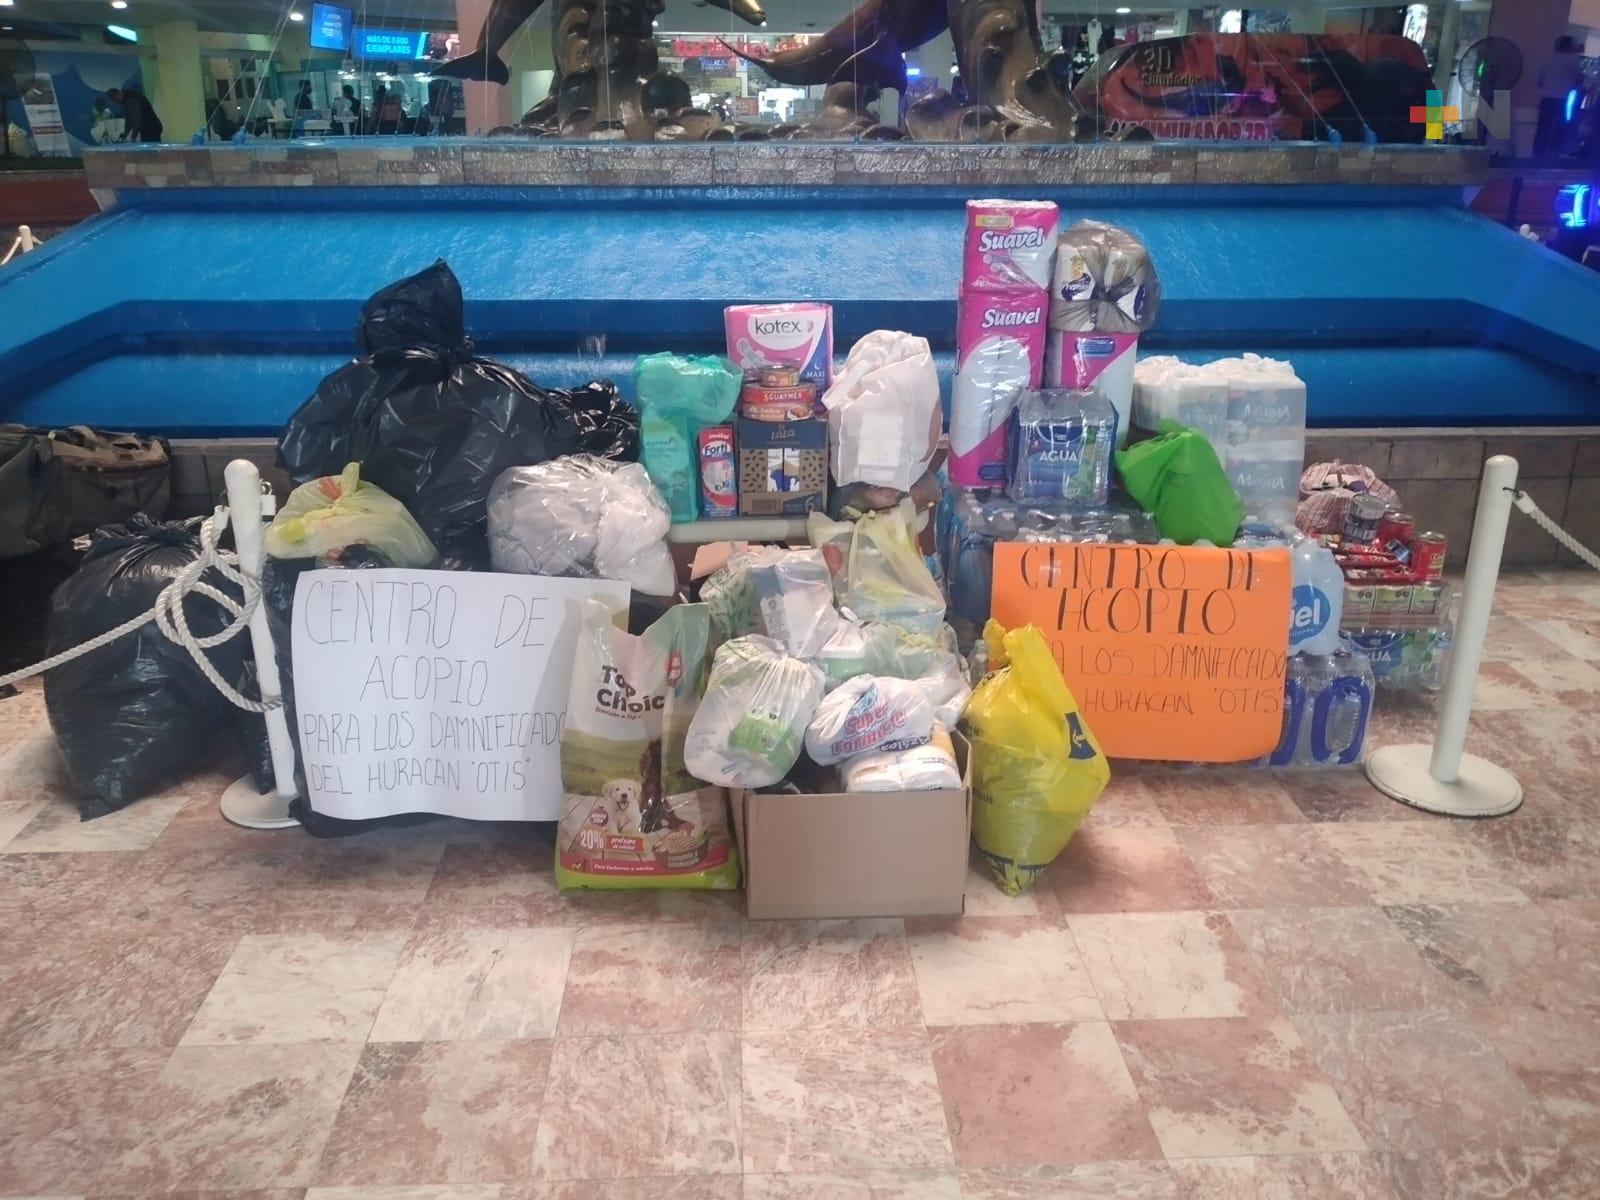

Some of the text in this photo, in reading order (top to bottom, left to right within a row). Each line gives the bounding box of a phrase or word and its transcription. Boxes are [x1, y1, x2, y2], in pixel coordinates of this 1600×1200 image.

[978, 227, 1045, 252] Suavel
[755, 318, 801, 335] kotex
[982, 307, 1041, 328] Suavel
[1039, 450, 1078, 462] AGUA
[1020, 546, 1263, 591] CENTRO DE
[305, 580, 548, 649] CENTRO DE
[1057, 587, 1236, 635] ACOPIO
[1080, 645, 1134, 676] LOS
[360, 655, 489, 707] ACOPIO
[602, 665, 636, 698] Top
[597, 688, 665, 713] Choic
[1084, 686, 1194, 714] HURACAN
[303, 713, 360, 754] PARA
[373, 711, 416, 751] LOS
[310, 763, 352, 795] DEL
[367, 757, 460, 793] HURACAN
